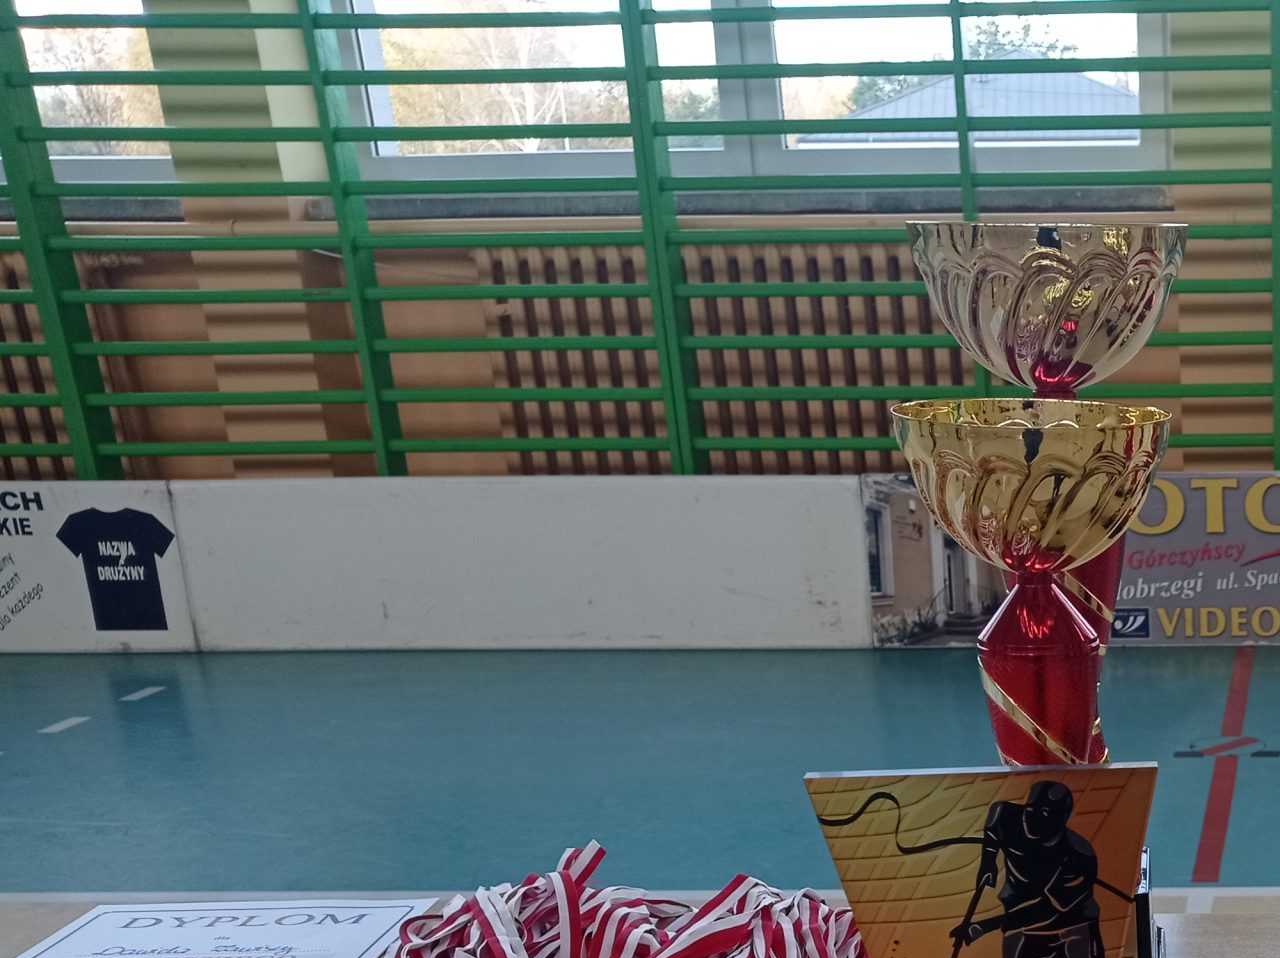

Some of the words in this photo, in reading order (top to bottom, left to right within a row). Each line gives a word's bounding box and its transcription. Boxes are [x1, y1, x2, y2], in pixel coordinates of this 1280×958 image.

[0, 491, 44, 511] CH
[97, 541, 136, 556] NAZWA
[1216, 572, 1239, 590] ul.
[118, 912, 370, 929] DYPLOM
